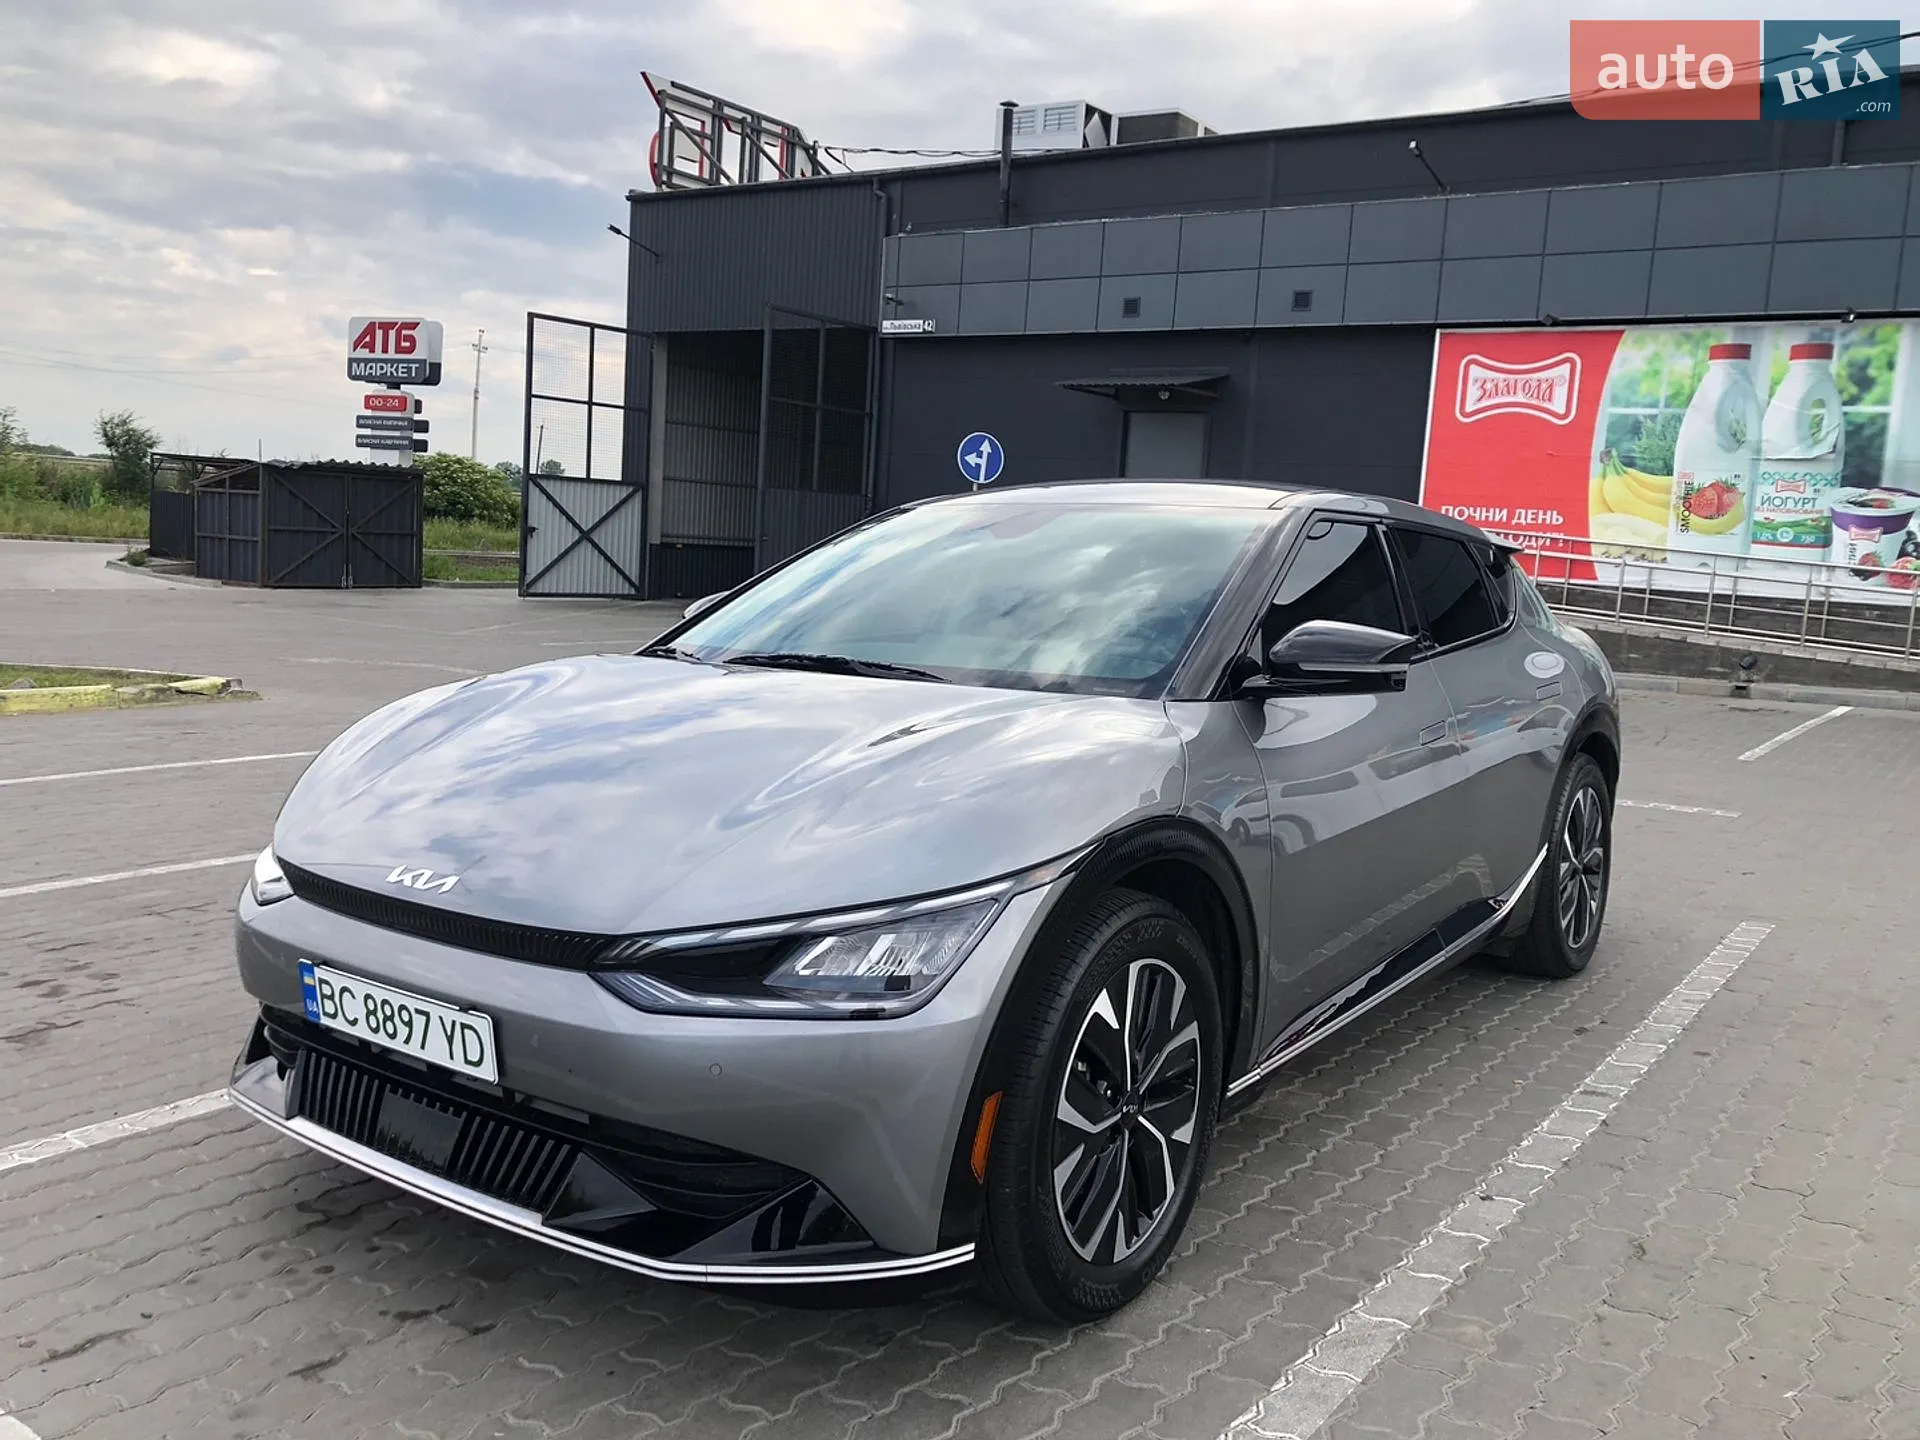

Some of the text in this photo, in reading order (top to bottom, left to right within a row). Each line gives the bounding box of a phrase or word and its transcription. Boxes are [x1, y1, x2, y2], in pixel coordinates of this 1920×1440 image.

[353, 321, 421, 355] АТБ
[351, 362, 420, 378] МАРКЕТ
[1680, 480, 1694, 533] SMOOTHIE
[1761, 492, 1818, 509] ЙОГУРТ
[1441, 505, 1565, 526] ПОЧНИ ДЕНЬ
[386, 864, 461, 895] KIA
[307, 998, 319, 1014] UA
[317, 976, 485, 1068] BC 8897 YD
